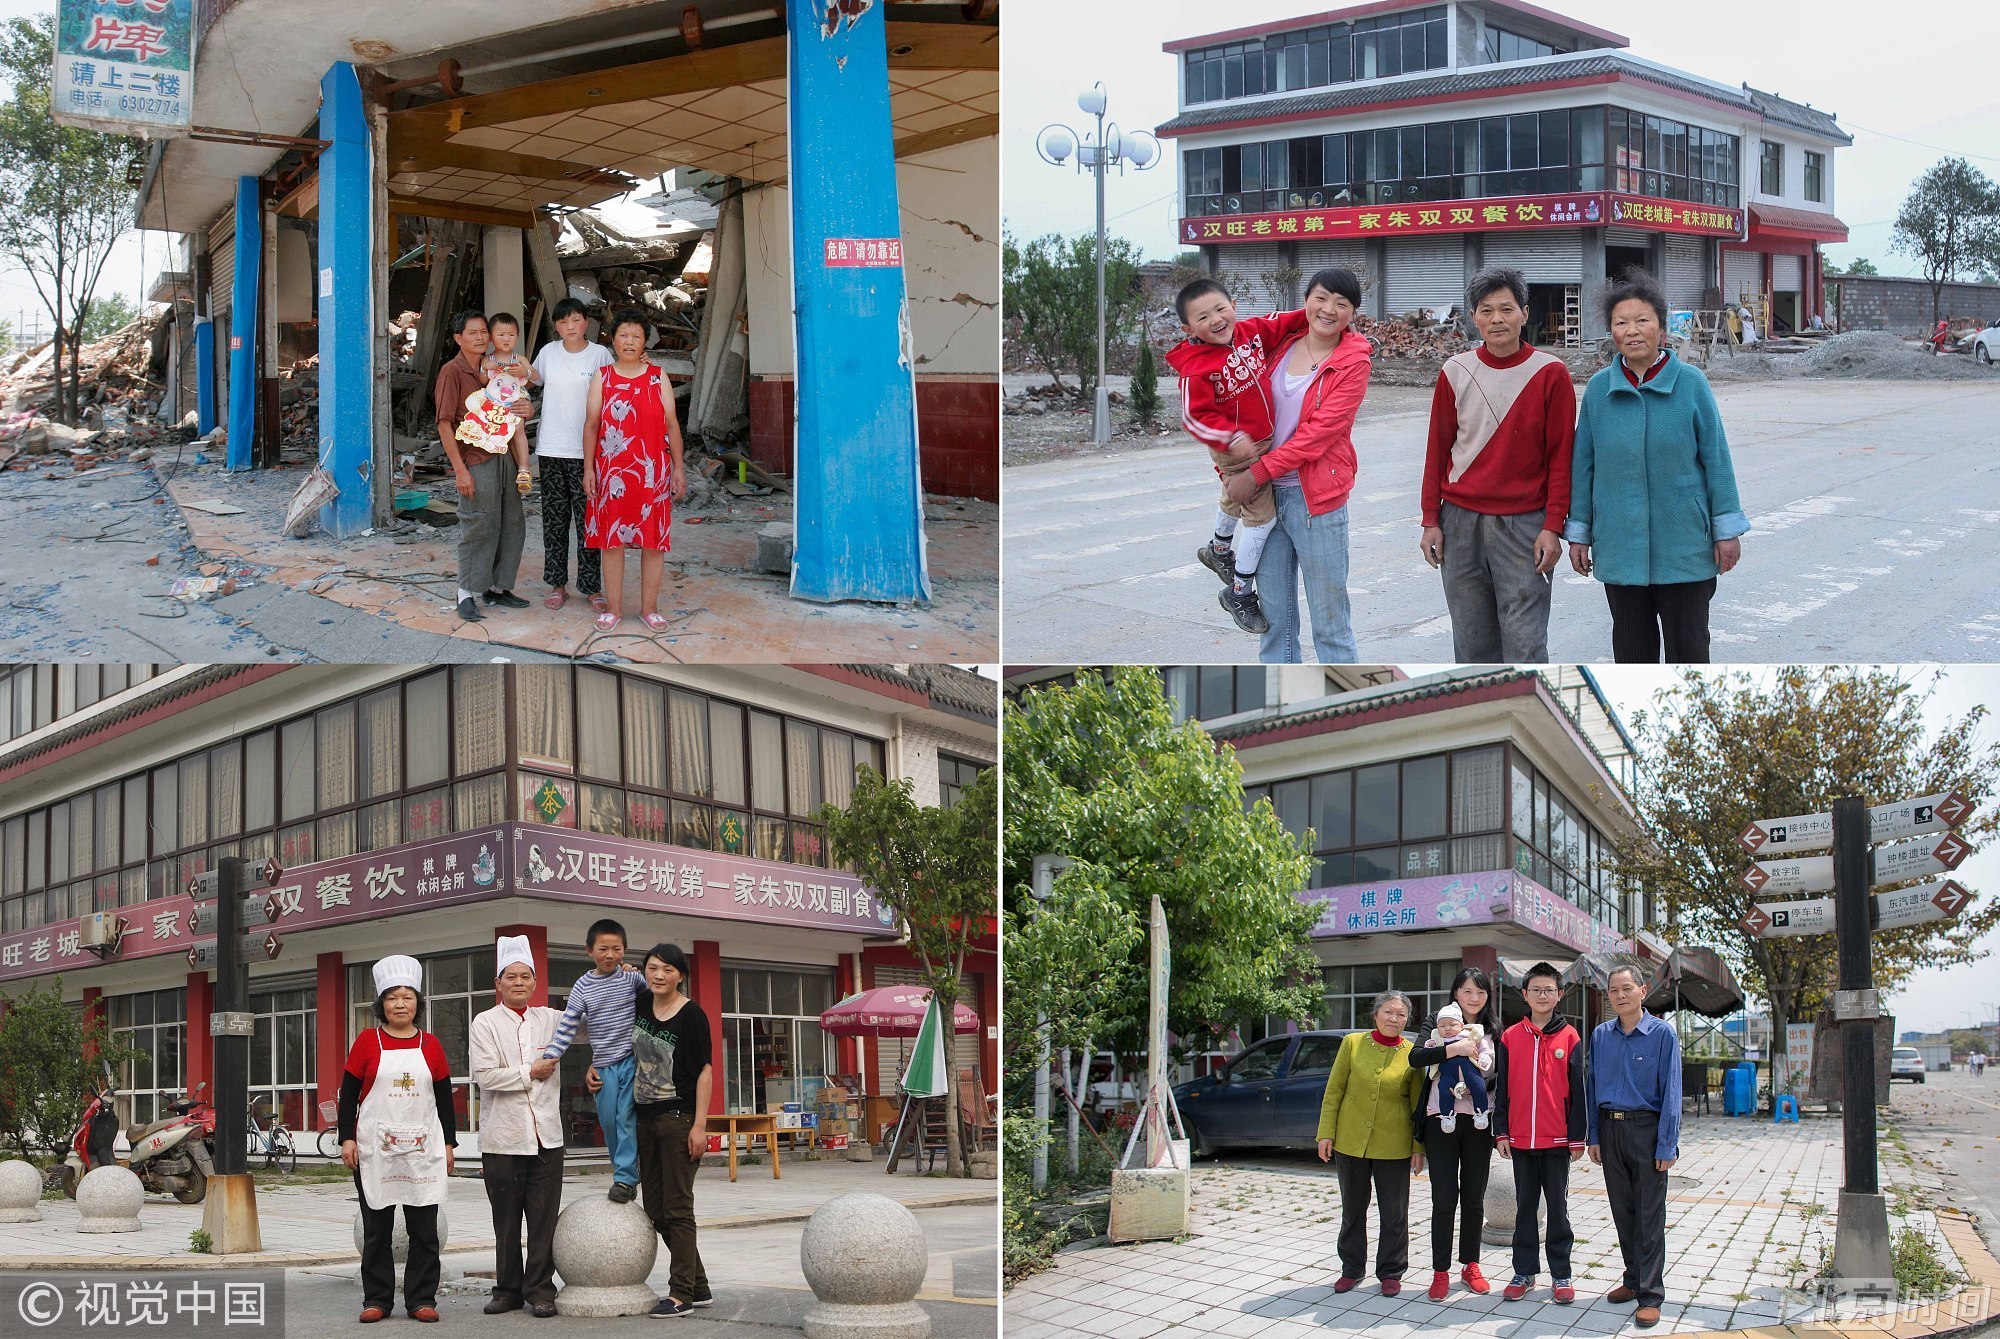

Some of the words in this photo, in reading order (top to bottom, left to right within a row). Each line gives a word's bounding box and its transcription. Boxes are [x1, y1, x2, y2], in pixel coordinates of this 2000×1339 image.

[70, 62, 180, 98] 请上二楼
[119, 95, 180, 116] 6302774
[1203, 203, 1543, 237] 汉旺老城第一家朱双双餐饮
[1550, 212, 1581, 222] 休闲会所
[1622, 201, 1733, 230] 汉旺老城第一家朱双双副食
[541, 785, 562, 814] 茶
[1789, 820, 1830, 833] 接待中心
[1869, 808, 1910, 824] 入口广场
[723, 818, 740, 843] 茶
[1407, 849, 1440, 871] 品茗
[1887, 845, 1930, 864] 钟楼遗址
[556, 845, 873, 919] 汉旺老城第一家朱双双副食
[1772, 866, 1800, 877] 数字馆
[417, 872, 465, 896] 休闲会所
[1889, 892, 1931, 908] 东汽遗址
[2, 863, 406, 968] 旺老城一家双餐饮
[1347, 907, 1417, 930] 休闲会所
[1792, 906, 1823, 917] 停车场
